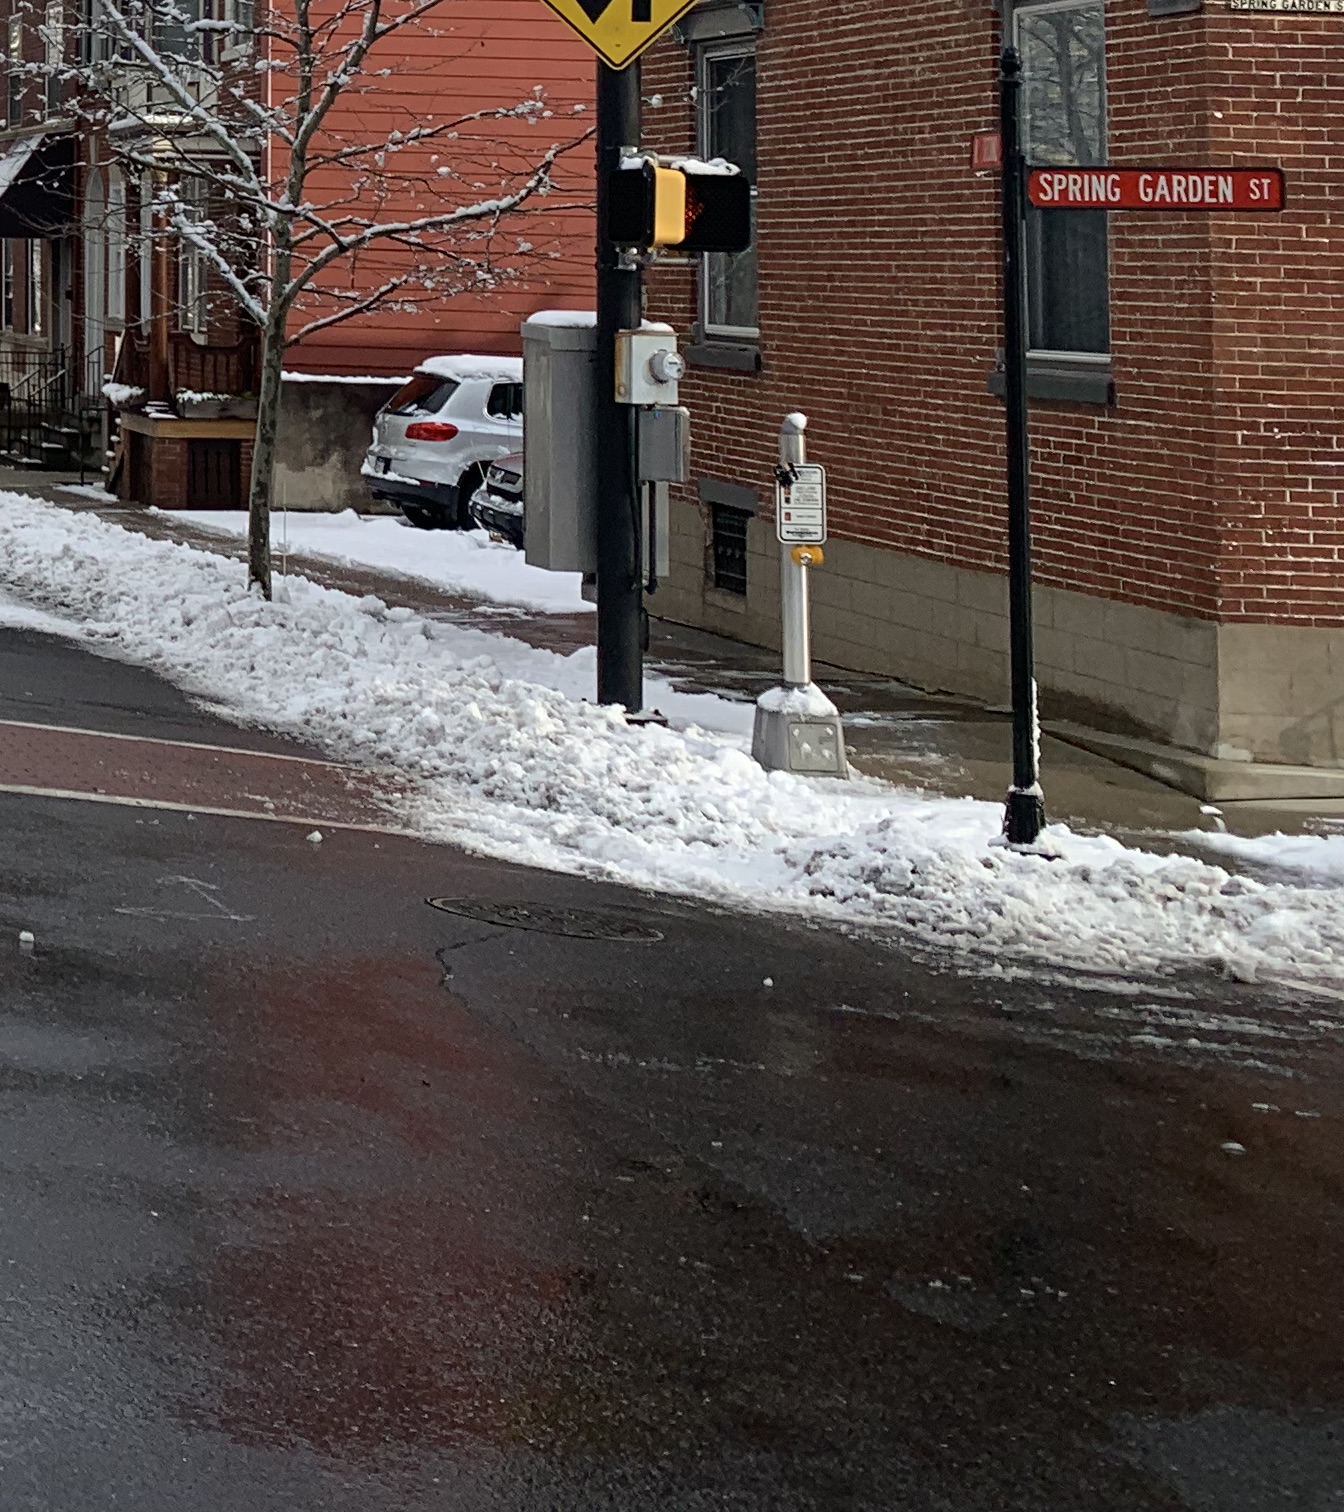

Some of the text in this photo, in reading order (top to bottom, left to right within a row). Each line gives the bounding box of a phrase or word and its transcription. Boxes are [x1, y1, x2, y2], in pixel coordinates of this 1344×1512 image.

[1281, 0, 1331, 11] GARDEN
[1038, 173, 1271, 203] SPRING GARDEN ST
